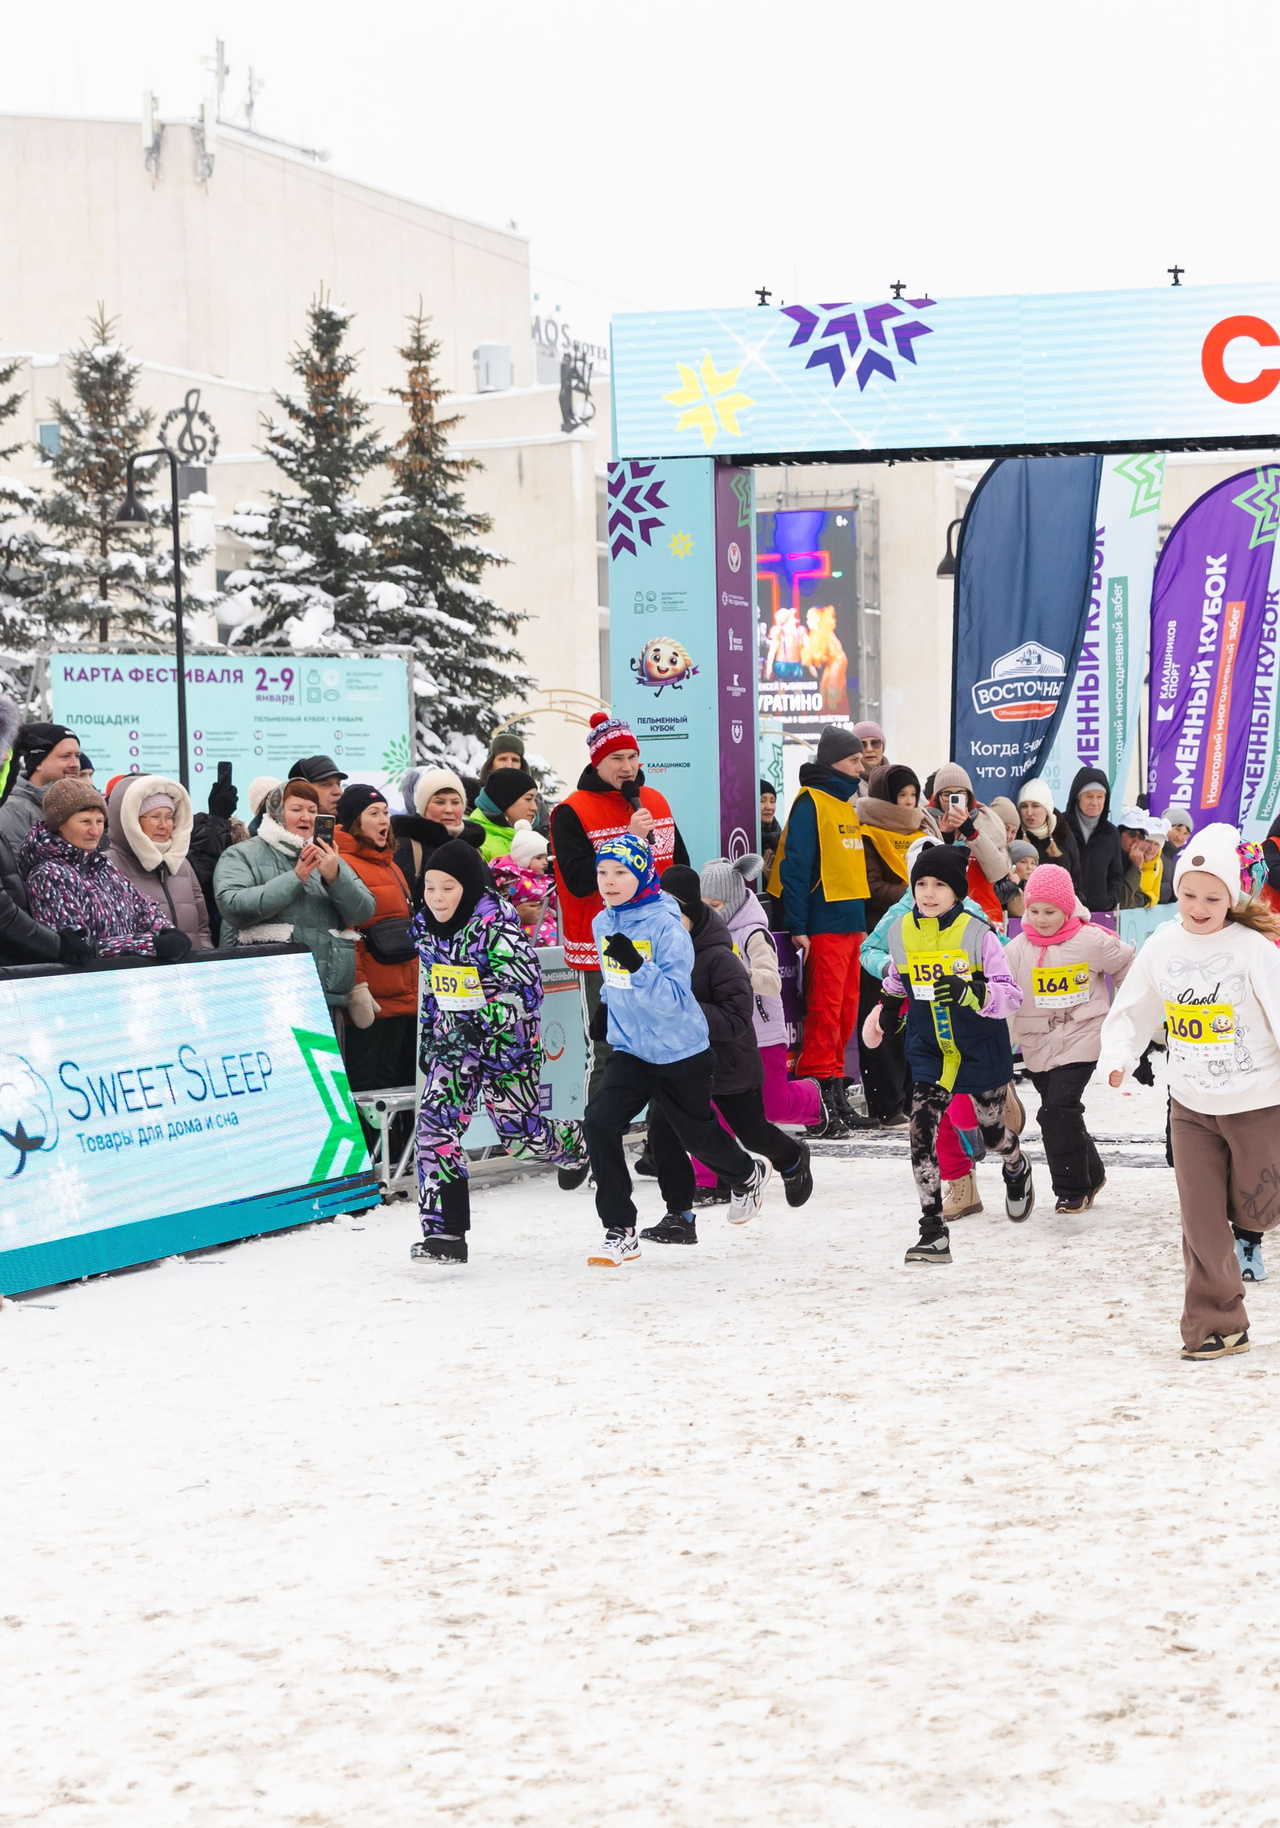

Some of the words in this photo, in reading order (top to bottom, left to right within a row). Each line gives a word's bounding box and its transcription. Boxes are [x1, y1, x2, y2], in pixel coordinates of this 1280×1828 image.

[1198, 553, 1228, 653] КУБОК
[1159, 620, 1178, 699] КАЛАШНИКОВ
[64, 667, 124, 682] КАРТА
[1168, 662, 1181, 699] СПОРТ
[255, 694, 294, 705] января
[977, 681, 1065, 704] ВОСТОЧНЫ
[1206, 733, 1223, 804] Новогодний
[1228, 607, 1241, 641] забег
[66, 715, 140, 726] ПЛОЩАДКИ
[637, 715, 688, 724] ПЕЛЬМЕННЫЙ
[970, 740, 1020, 758] Когда
[976, 766, 1007, 778] что
[913, 964, 945, 982] 158
[435, 976, 457, 993] 159
[1037, 977, 1069, 993] 164
[1170, 1015, 1203, 1039] 160
[76, 1128, 134, 1153] Товары
[138, 1123, 164, 1148] для
[167, 1120, 203, 1141] дома
[206, 1117, 214, 1131] и
[216, 1111, 239, 1129] сна
